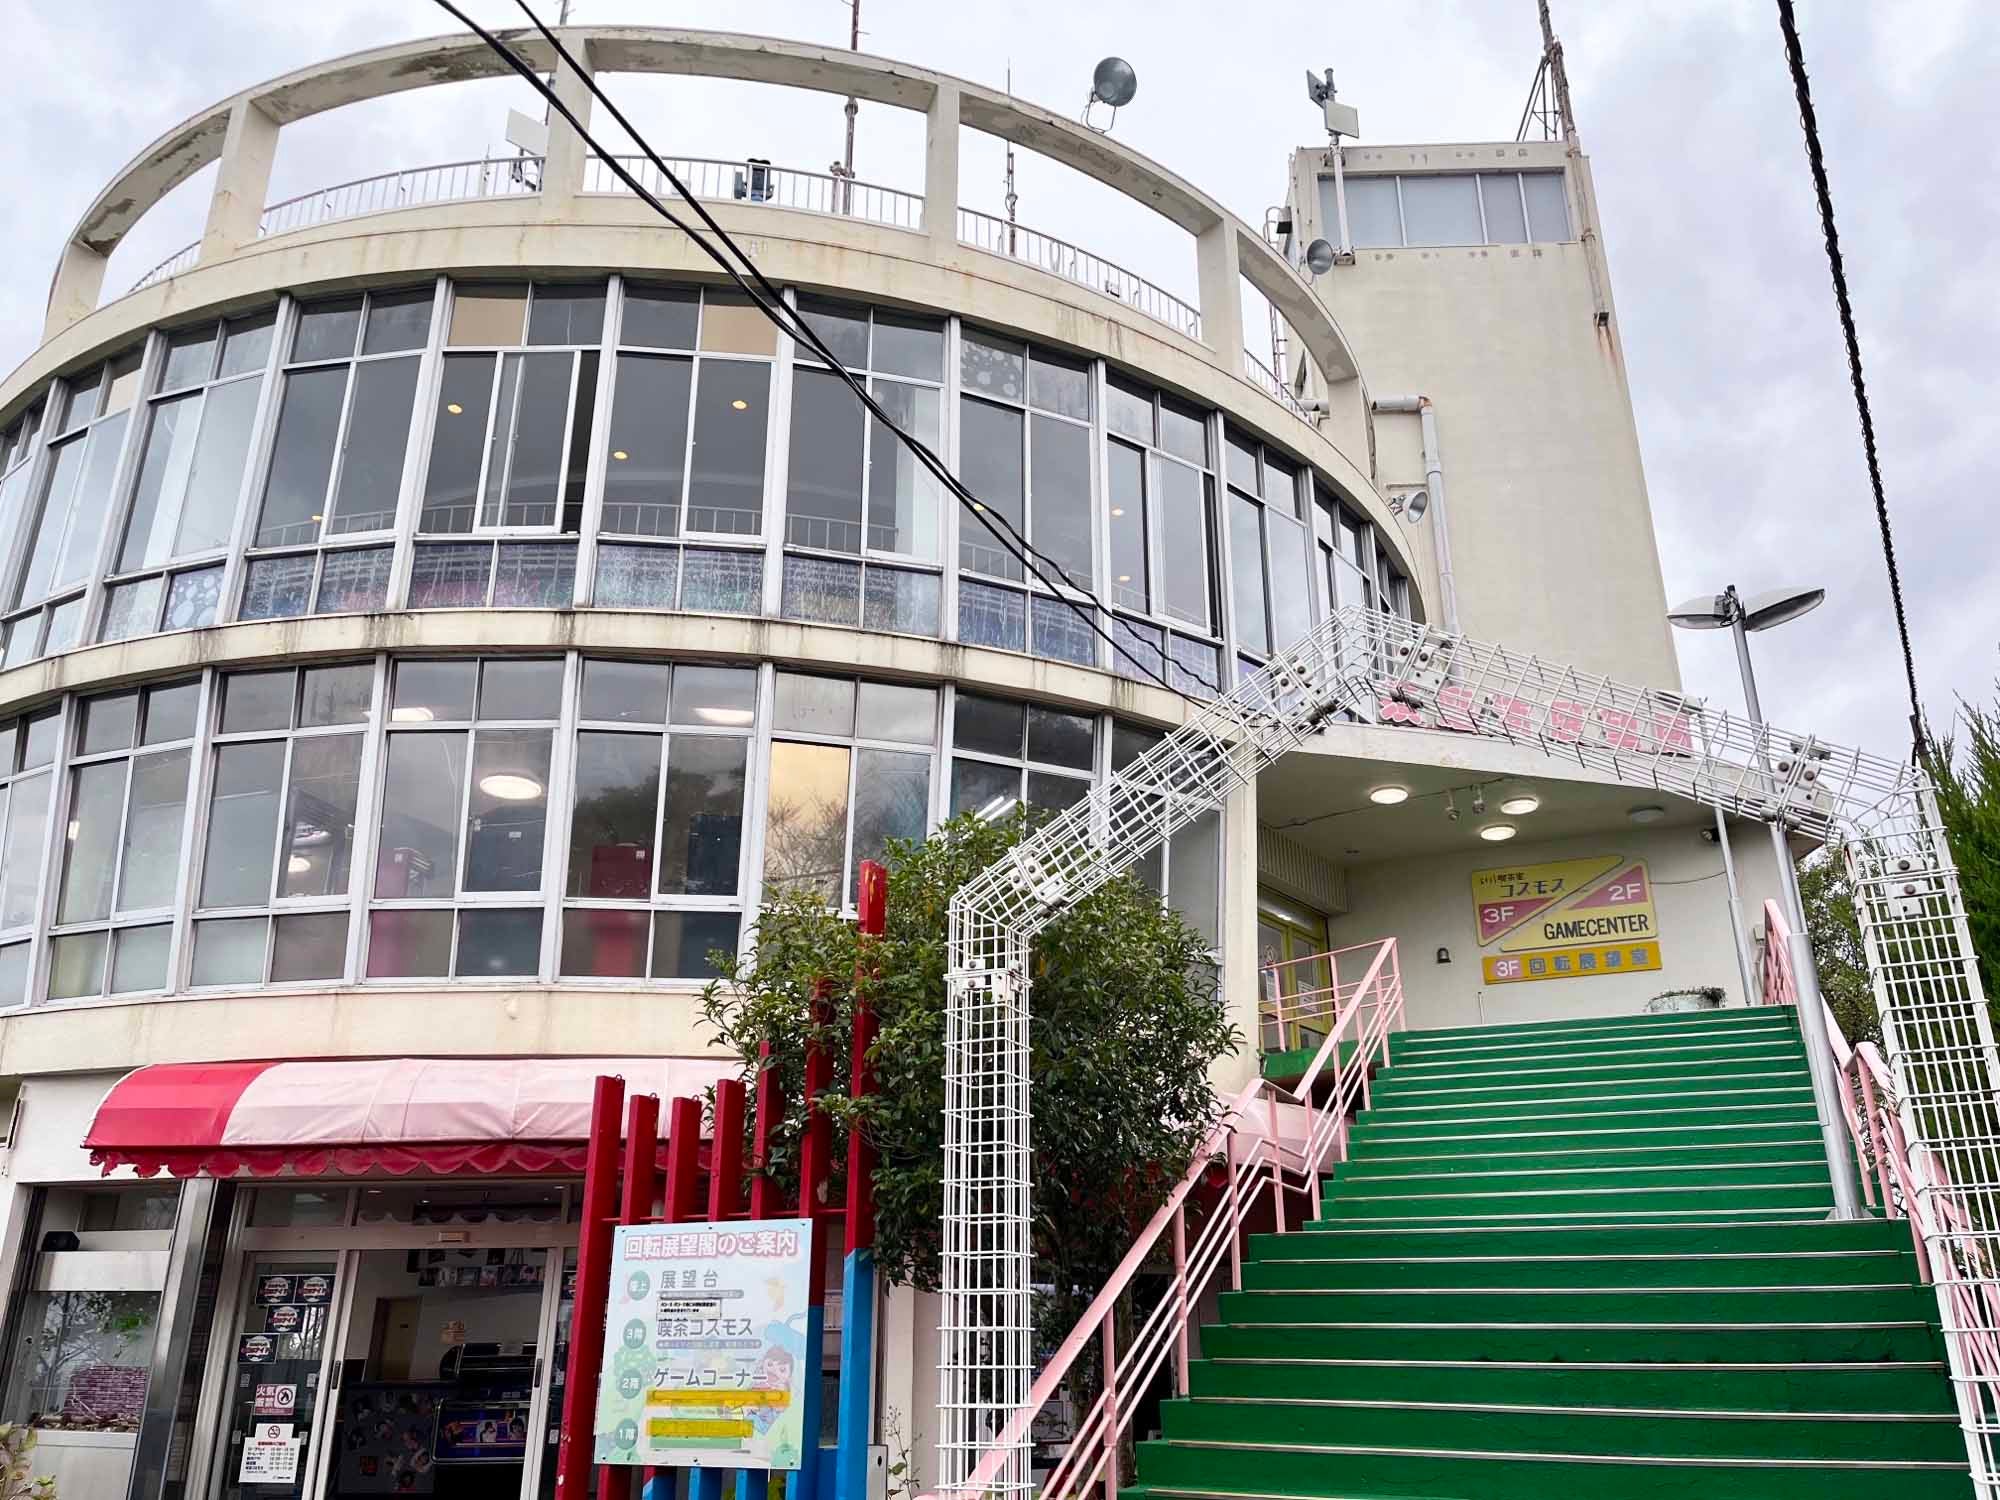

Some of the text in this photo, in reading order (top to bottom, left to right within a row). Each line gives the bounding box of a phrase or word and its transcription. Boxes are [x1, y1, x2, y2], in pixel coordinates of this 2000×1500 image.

[1500, 878, 1565, 897] コスモス
[1608, 883, 1640, 901] 2F
[1483, 906, 1515, 923] 3F
[1544, 914, 1649, 940] GAMECENTER
[1496, 959, 1519, 977] 3F
[624, 1231, 798, 1259] 回転展望閣のご案内
[660, 1269, 718, 1289] 展望台
[657, 1318, 753, 1337] 喫茶コスモス
[654, 1368, 768, 1388] ゲームコーナー
